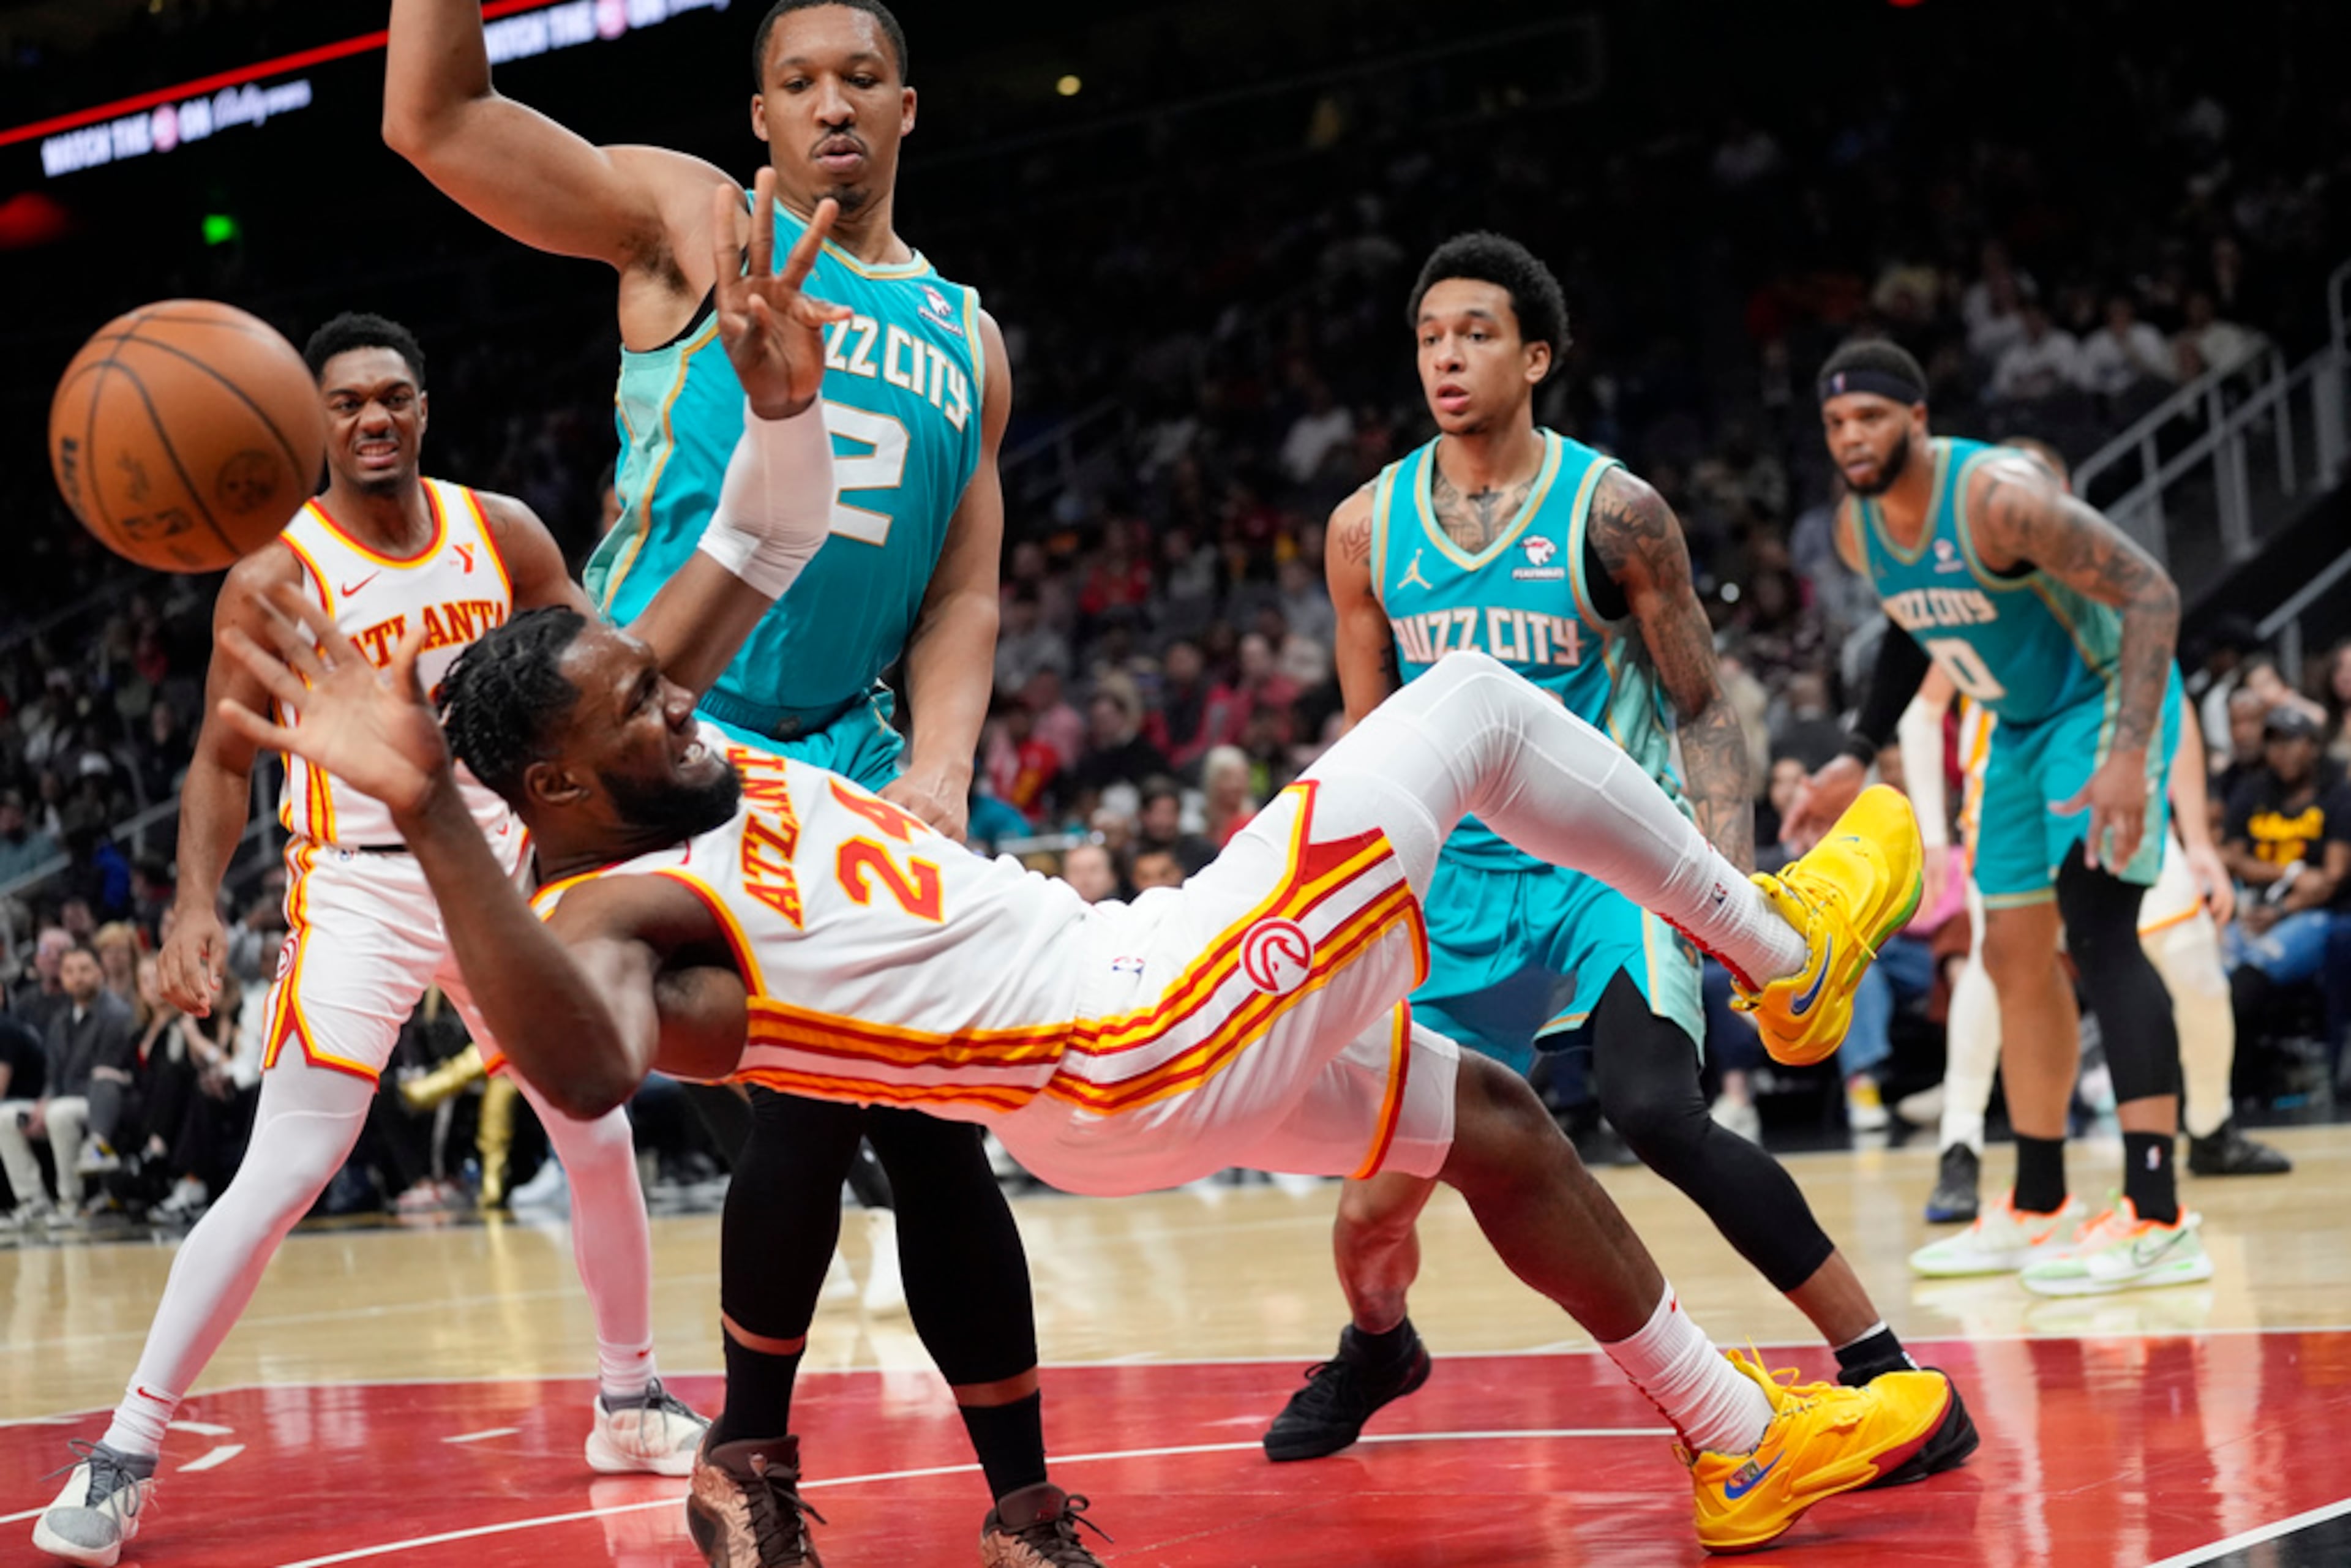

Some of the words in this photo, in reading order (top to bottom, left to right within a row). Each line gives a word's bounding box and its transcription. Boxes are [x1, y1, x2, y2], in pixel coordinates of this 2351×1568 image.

[111, 111, 152, 160] THE
[824, 315, 879, 379] ZZ
[883, 323, 973, 433] CITY
[1485, 606, 1586, 666] CITY
[1925, 636, 2008, 700] 0
[828, 775, 944, 924] 24
